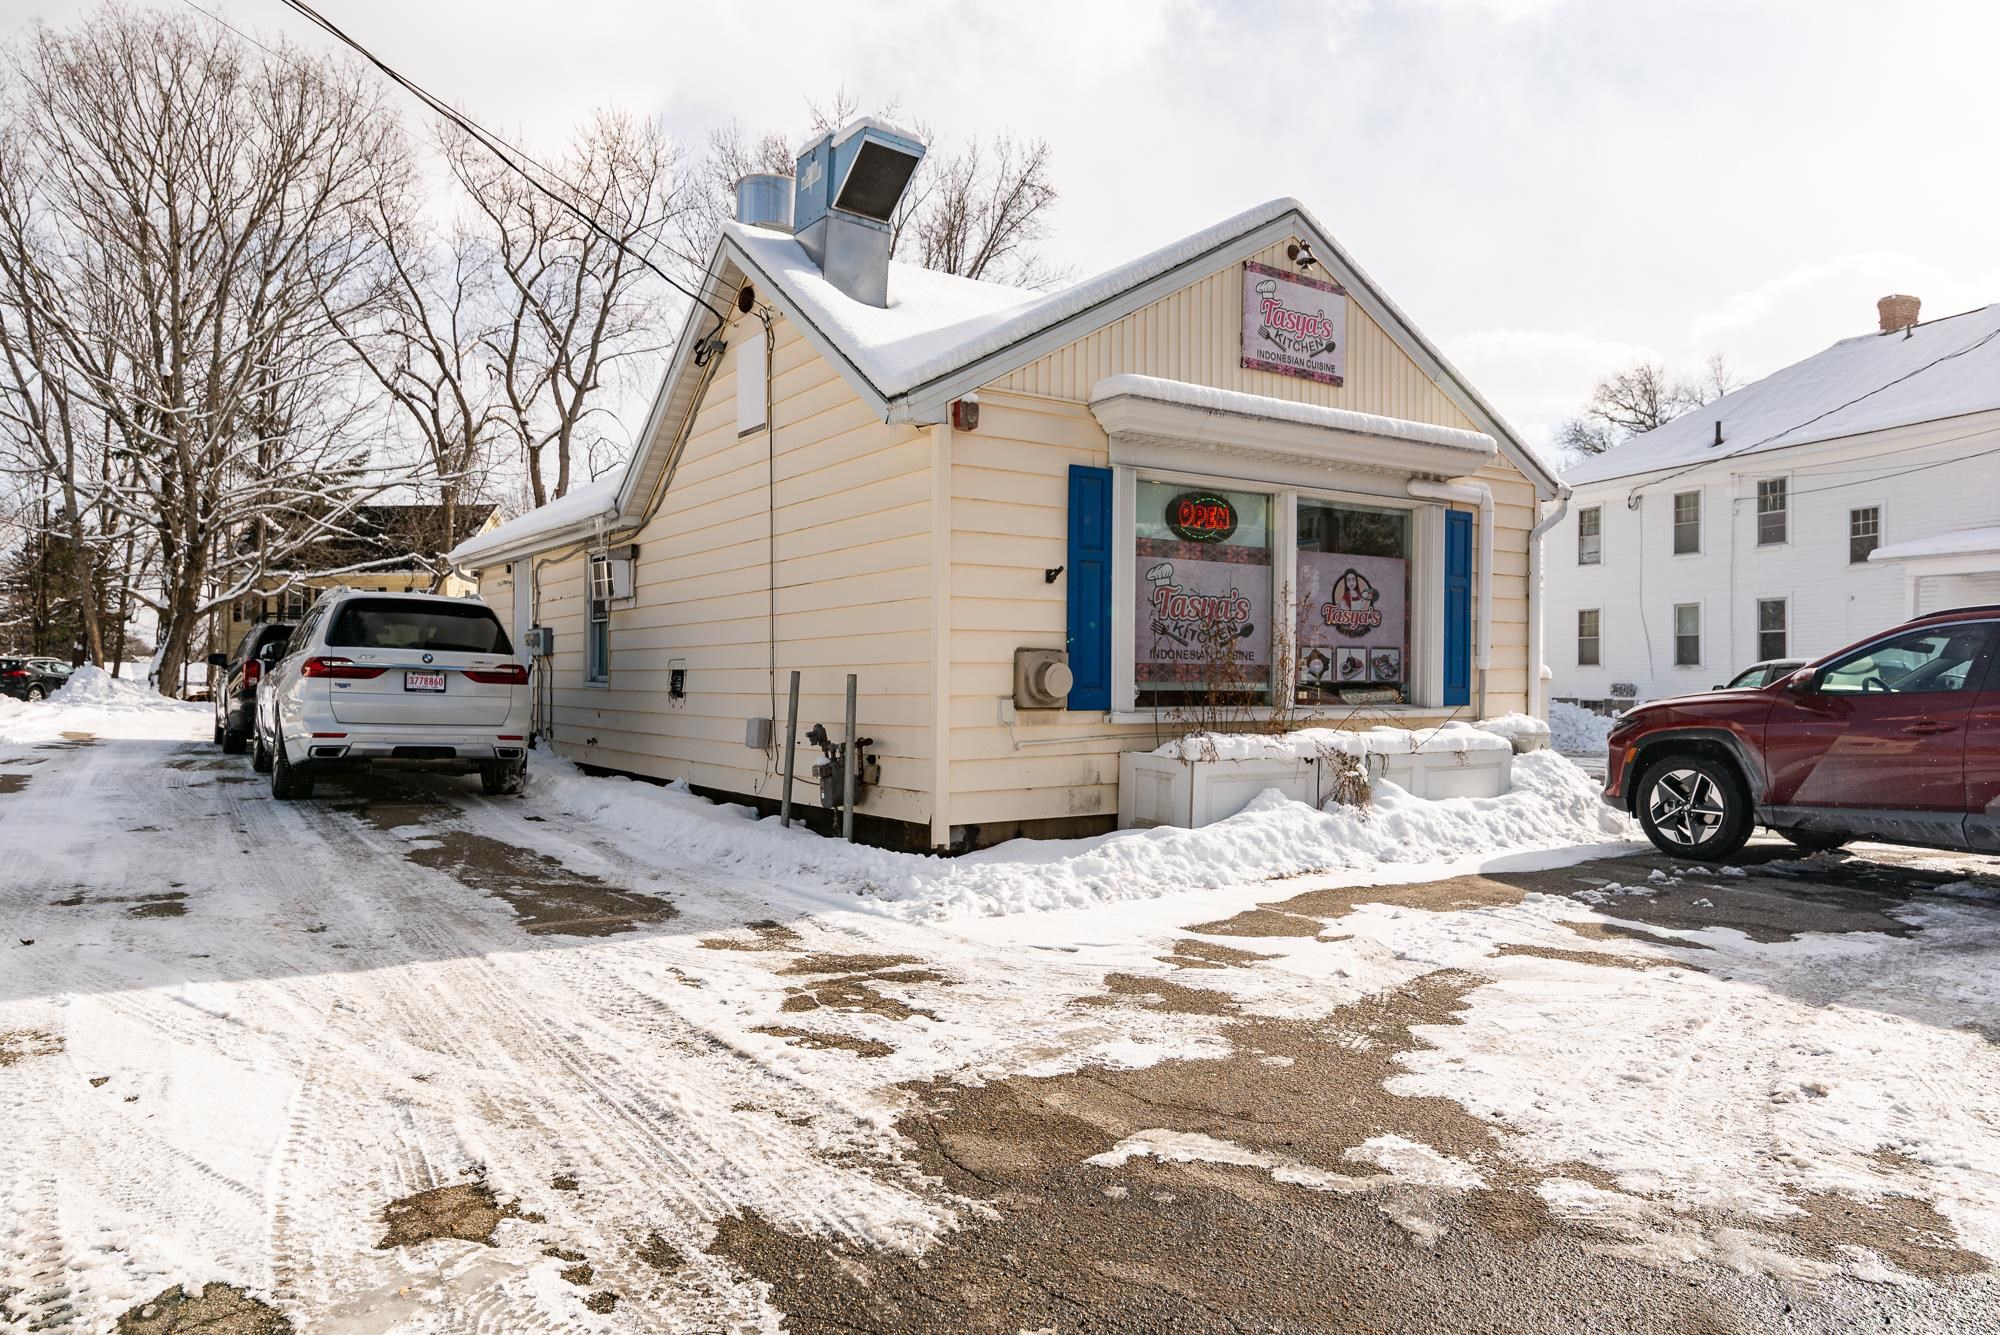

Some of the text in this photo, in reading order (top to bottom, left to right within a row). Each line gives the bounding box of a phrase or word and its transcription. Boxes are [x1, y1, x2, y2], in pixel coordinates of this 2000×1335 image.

[1260, 298, 1333, 340] Tasya's
[1274, 330, 1324, 353] KITCHEN
[1256, 349, 1336, 373] INDONESIAN CUISINE
[1178, 500, 1230, 530] OPEN
[1153, 584, 1251, 631] Tasya's
[1321, 602, 1382, 630] Tasya's
[1149, 649, 1213, 661] INDONESIAN
[409, 676, 444, 686] 3778860
